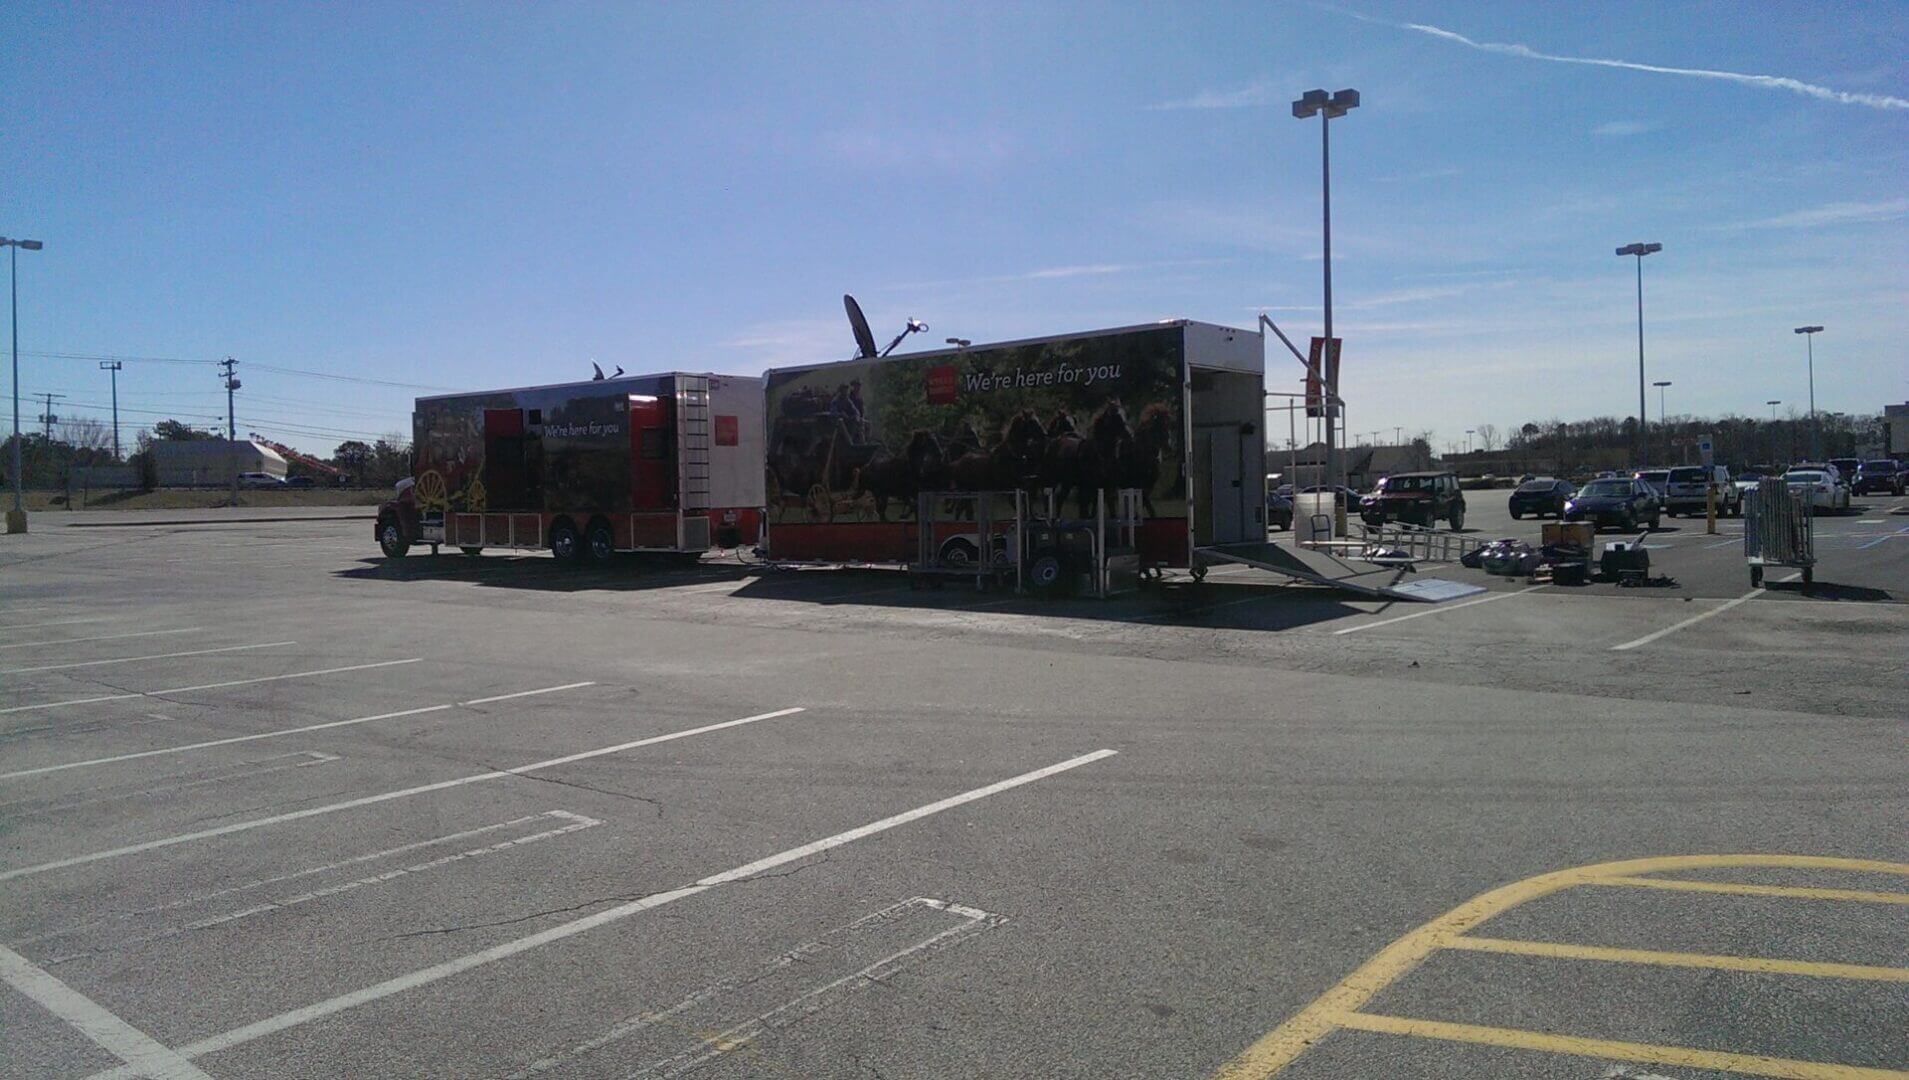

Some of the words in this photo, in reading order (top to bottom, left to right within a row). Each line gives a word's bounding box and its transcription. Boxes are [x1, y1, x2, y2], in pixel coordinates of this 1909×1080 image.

[965, 372, 1011, 392] We're
[1015, 368, 1053, 388] here
[1057, 362, 1083, 384] for
[1084, 364, 1121, 386] you
[544, 424, 568, 437] We're
[568, 422, 587, 436] here
[588, 421, 602, 434] for
[602, 424, 619, 437] you
